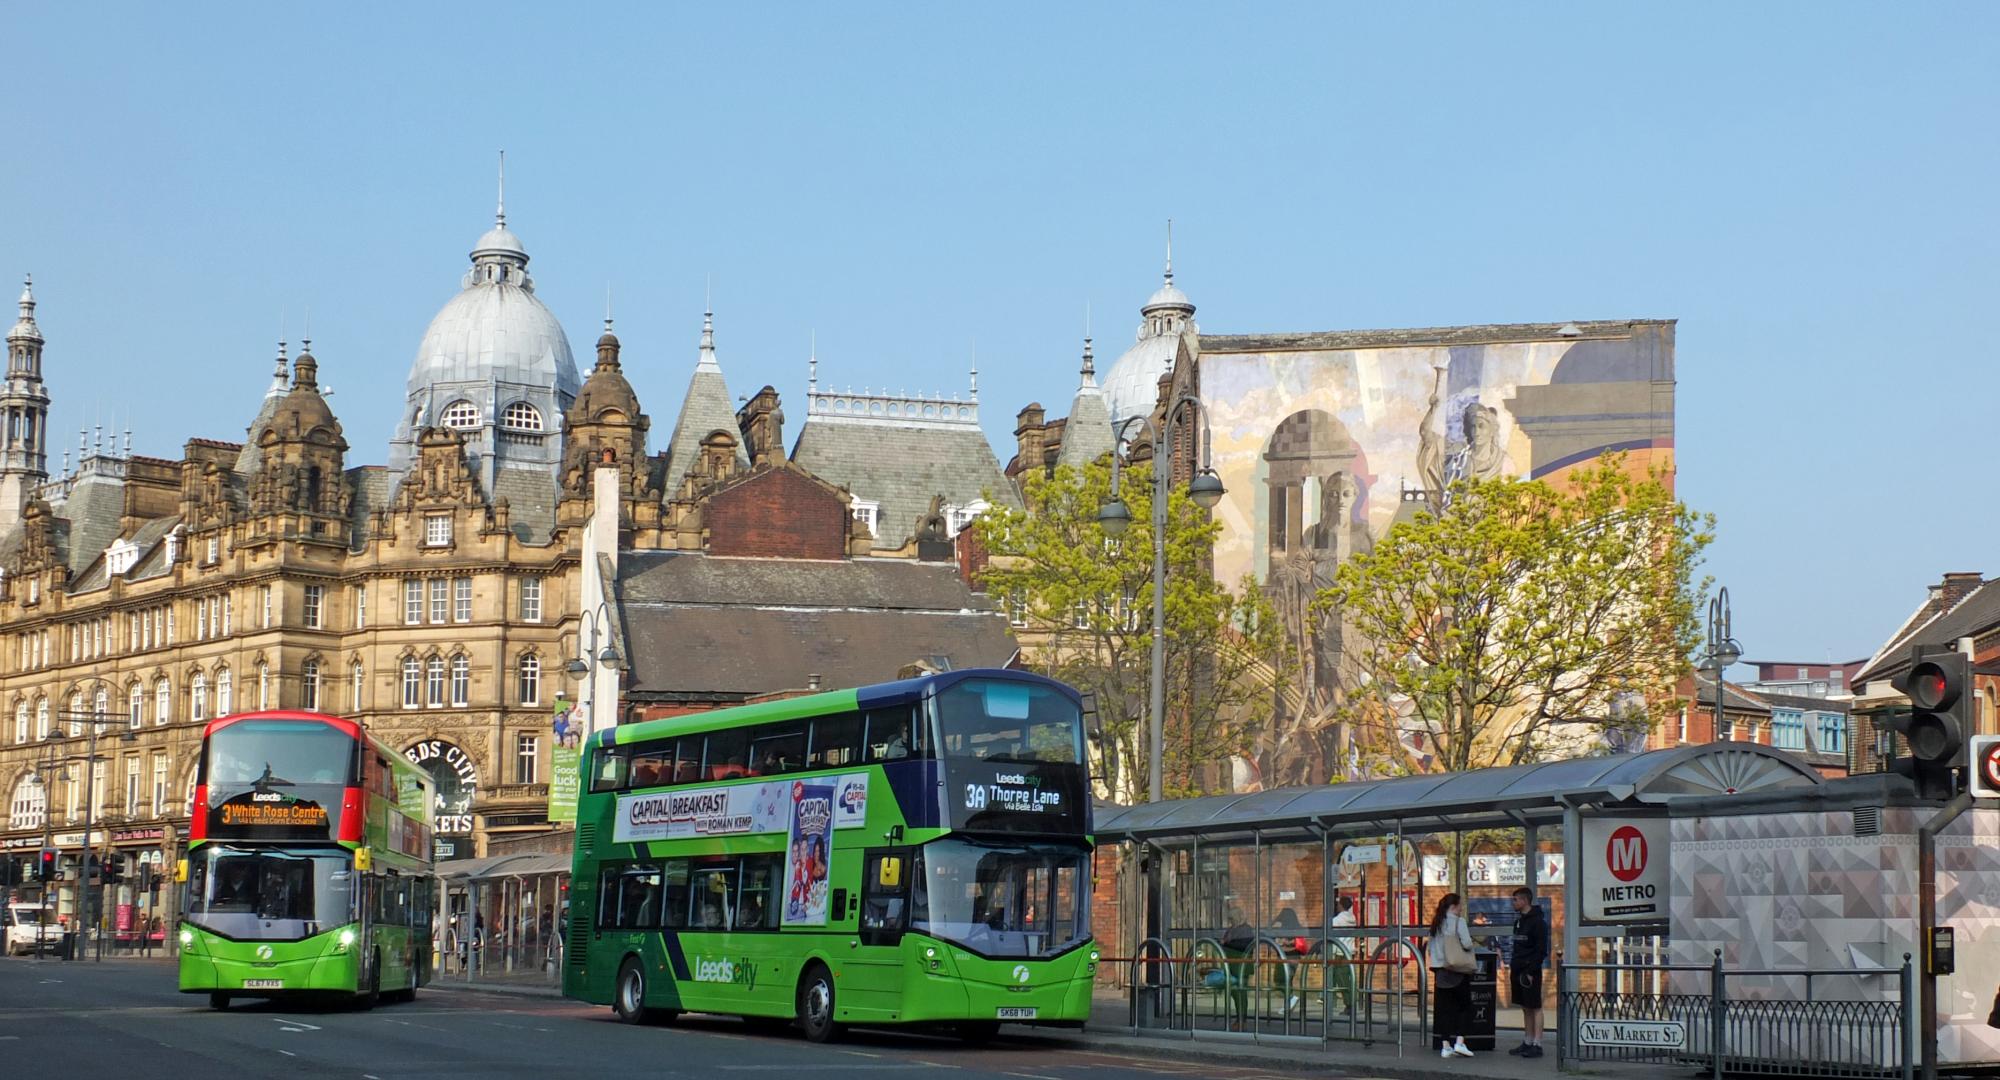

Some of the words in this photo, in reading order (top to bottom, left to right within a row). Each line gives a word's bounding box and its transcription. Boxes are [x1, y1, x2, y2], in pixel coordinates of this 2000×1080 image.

[405, 741, 441, 764] EDS
[446, 747, 477, 785] CITY
[554, 765, 577, 774] Good
[554, 773, 576, 785] luck
[846, 791, 866, 801] CAPITAL
[965, 783, 985, 809] 3A
[990, 785, 1029, 802] Thorpe
[1033, 788, 1060, 805] Lane
[222, 804, 231, 824] 3
[232, 804, 260, 817] White
[263, 805, 289, 817] Rose
[291, 805, 327, 818] Centre
[632, 798, 668, 818] CAPITAL
[672, 794, 726, 815] BREAKFAST
[800, 800, 829, 817] CAPITAL
[708, 817, 733, 830] ROMAN
[734, 816, 752, 828] KEMP
[1612, 837, 1642, 871] M
[1437, 871, 1490, 881] PCE
[1602, 884, 1656, 902] METRO
[1000, 1008, 1019, 1017] SK68
